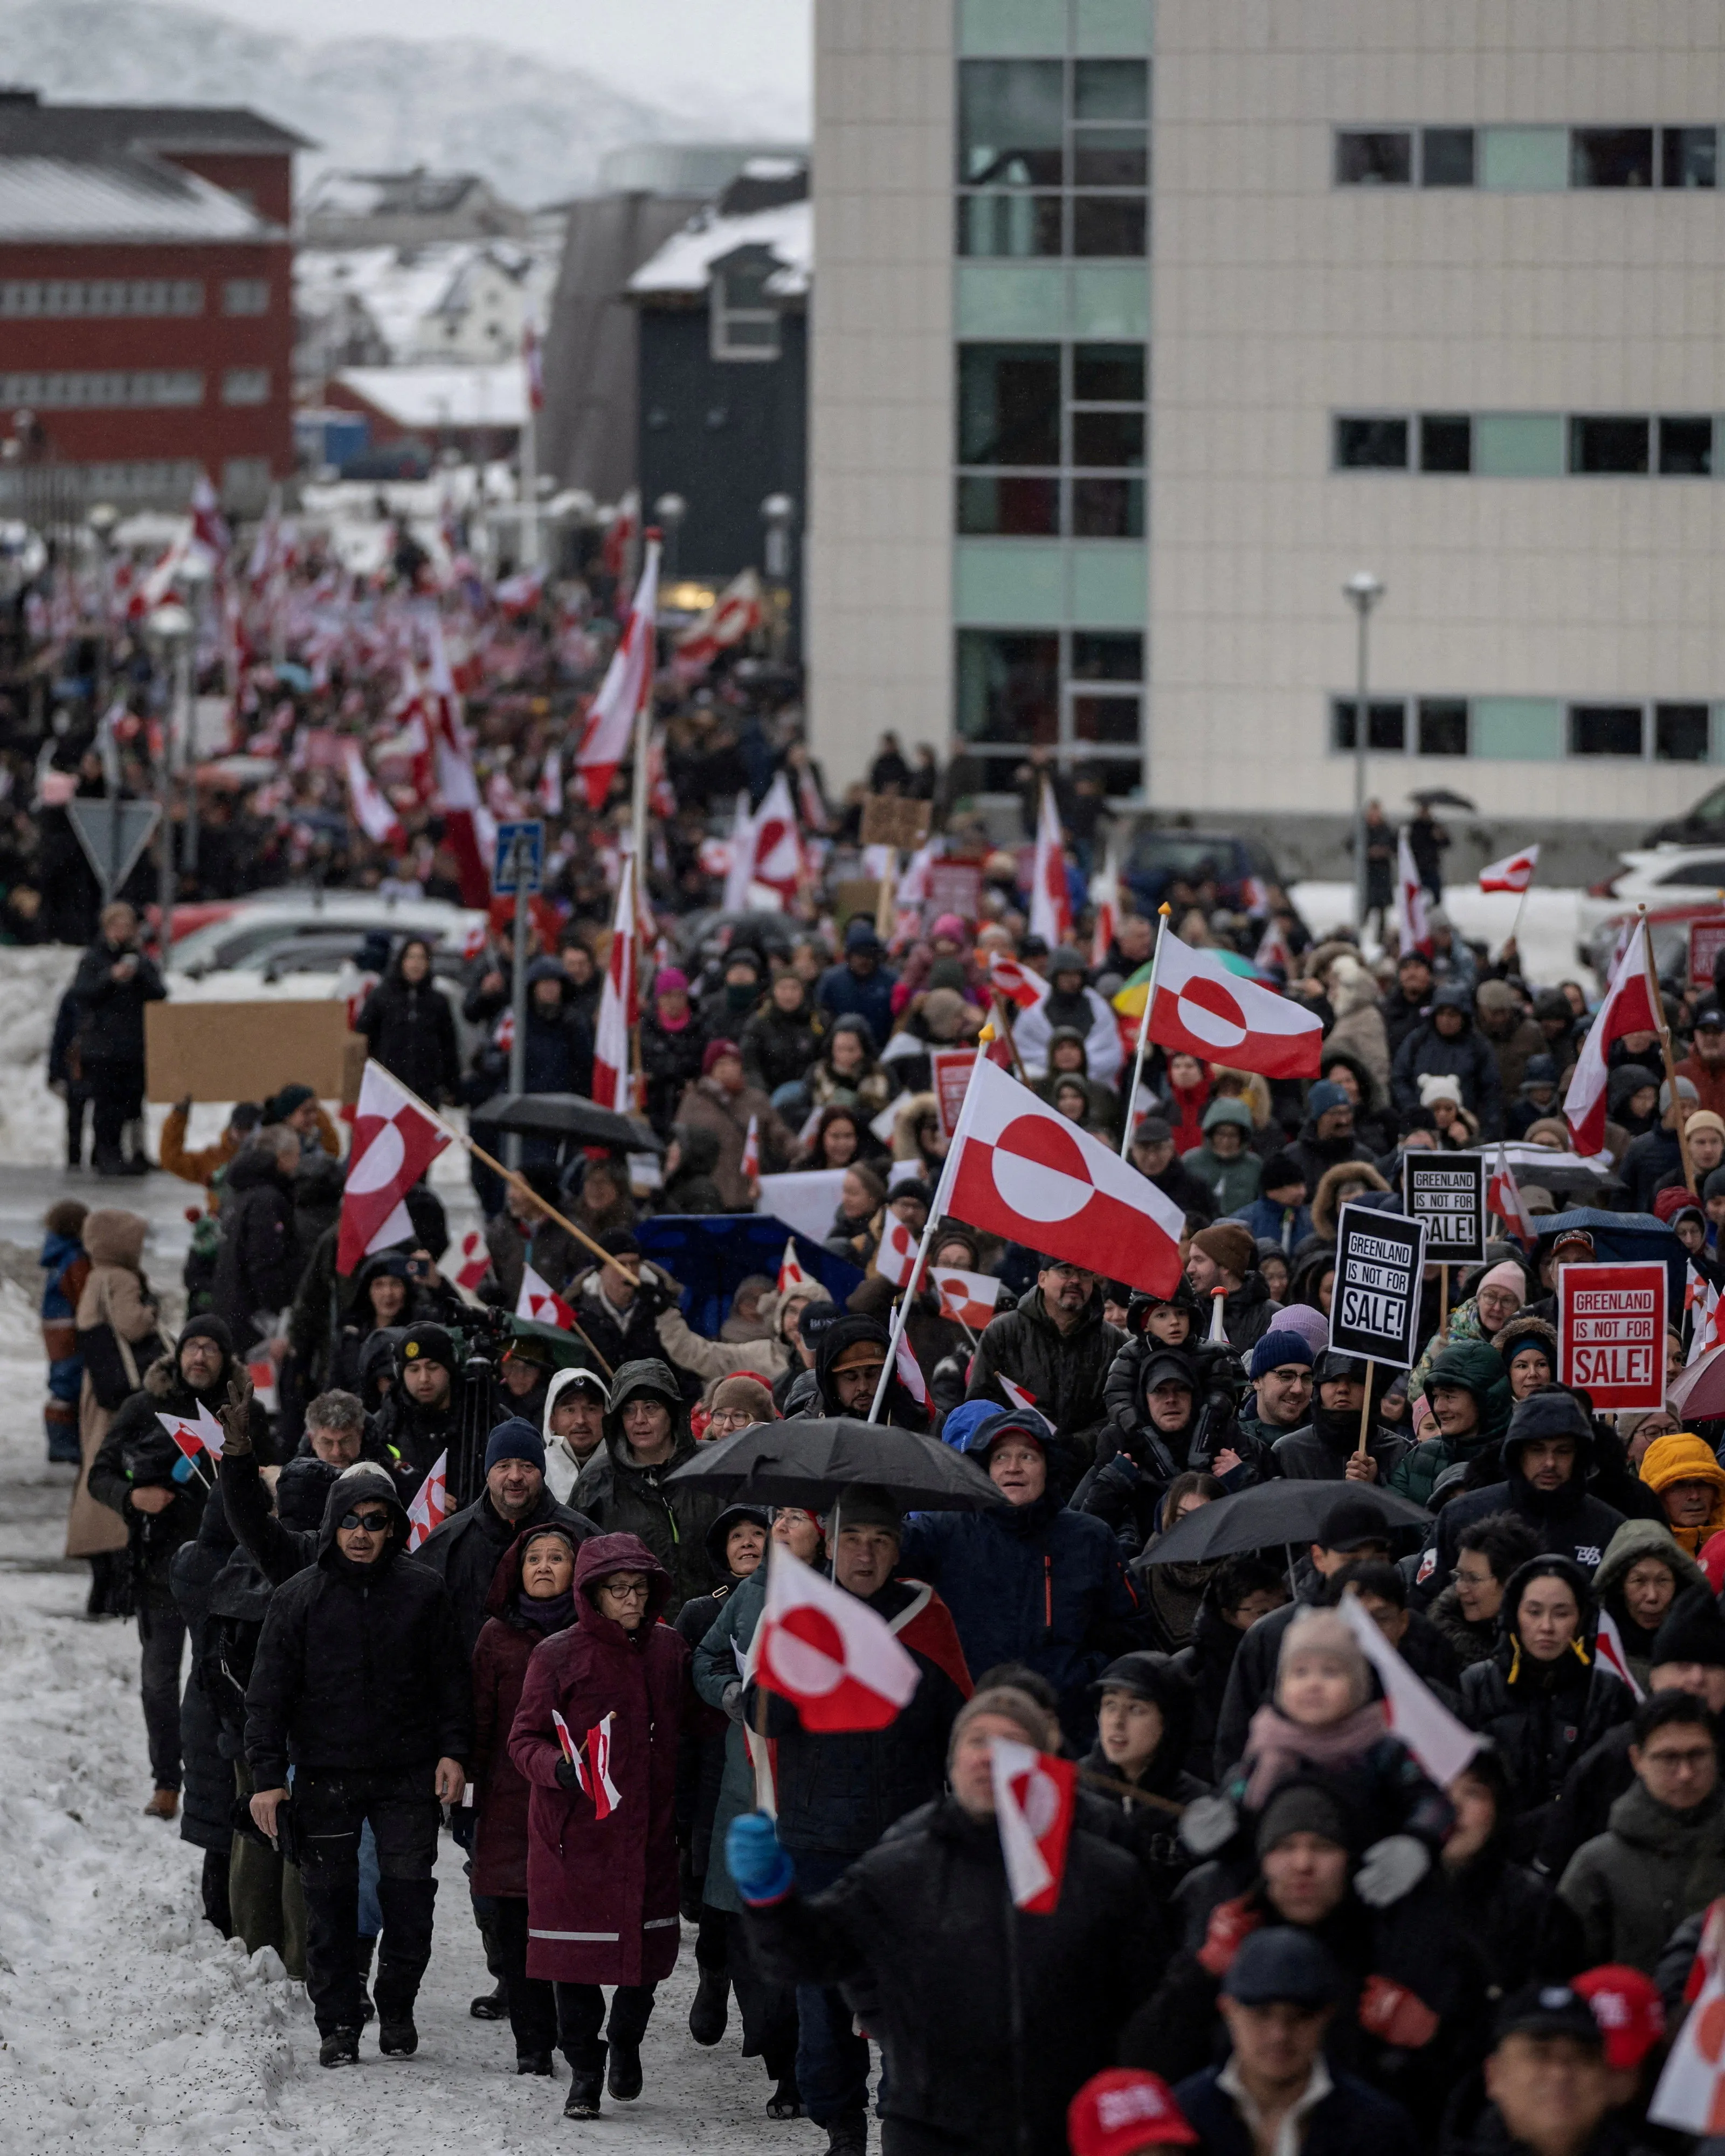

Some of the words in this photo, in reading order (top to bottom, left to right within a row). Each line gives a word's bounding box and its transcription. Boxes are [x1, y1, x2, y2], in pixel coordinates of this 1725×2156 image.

[1416, 1173, 1473, 1186] GREENLAND
[1416, 1194, 1425, 1207] IS
[1430, 1194, 1449, 1207] NOT
[1454, 1195, 1472, 1208] FOR
[1350, 1235, 1410, 1263] GREENLAND
[1348, 1262, 1357, 1280] IS
[1362, 1266, 1382, 1285] NOT
[1386, 1271, 1406, 1291] FOR
[1577, 1293, 1651, 1310] GREENLAND
[1344, 1290, 1403, 1337] SALE!
[1576, 1322, 1587, 1338] IS
[1595, 1321, 1620, 1338] NOT
[1626, 1321, 1650, 1337] FOR
[1575, 1349, 1650, 1384] SALE!
